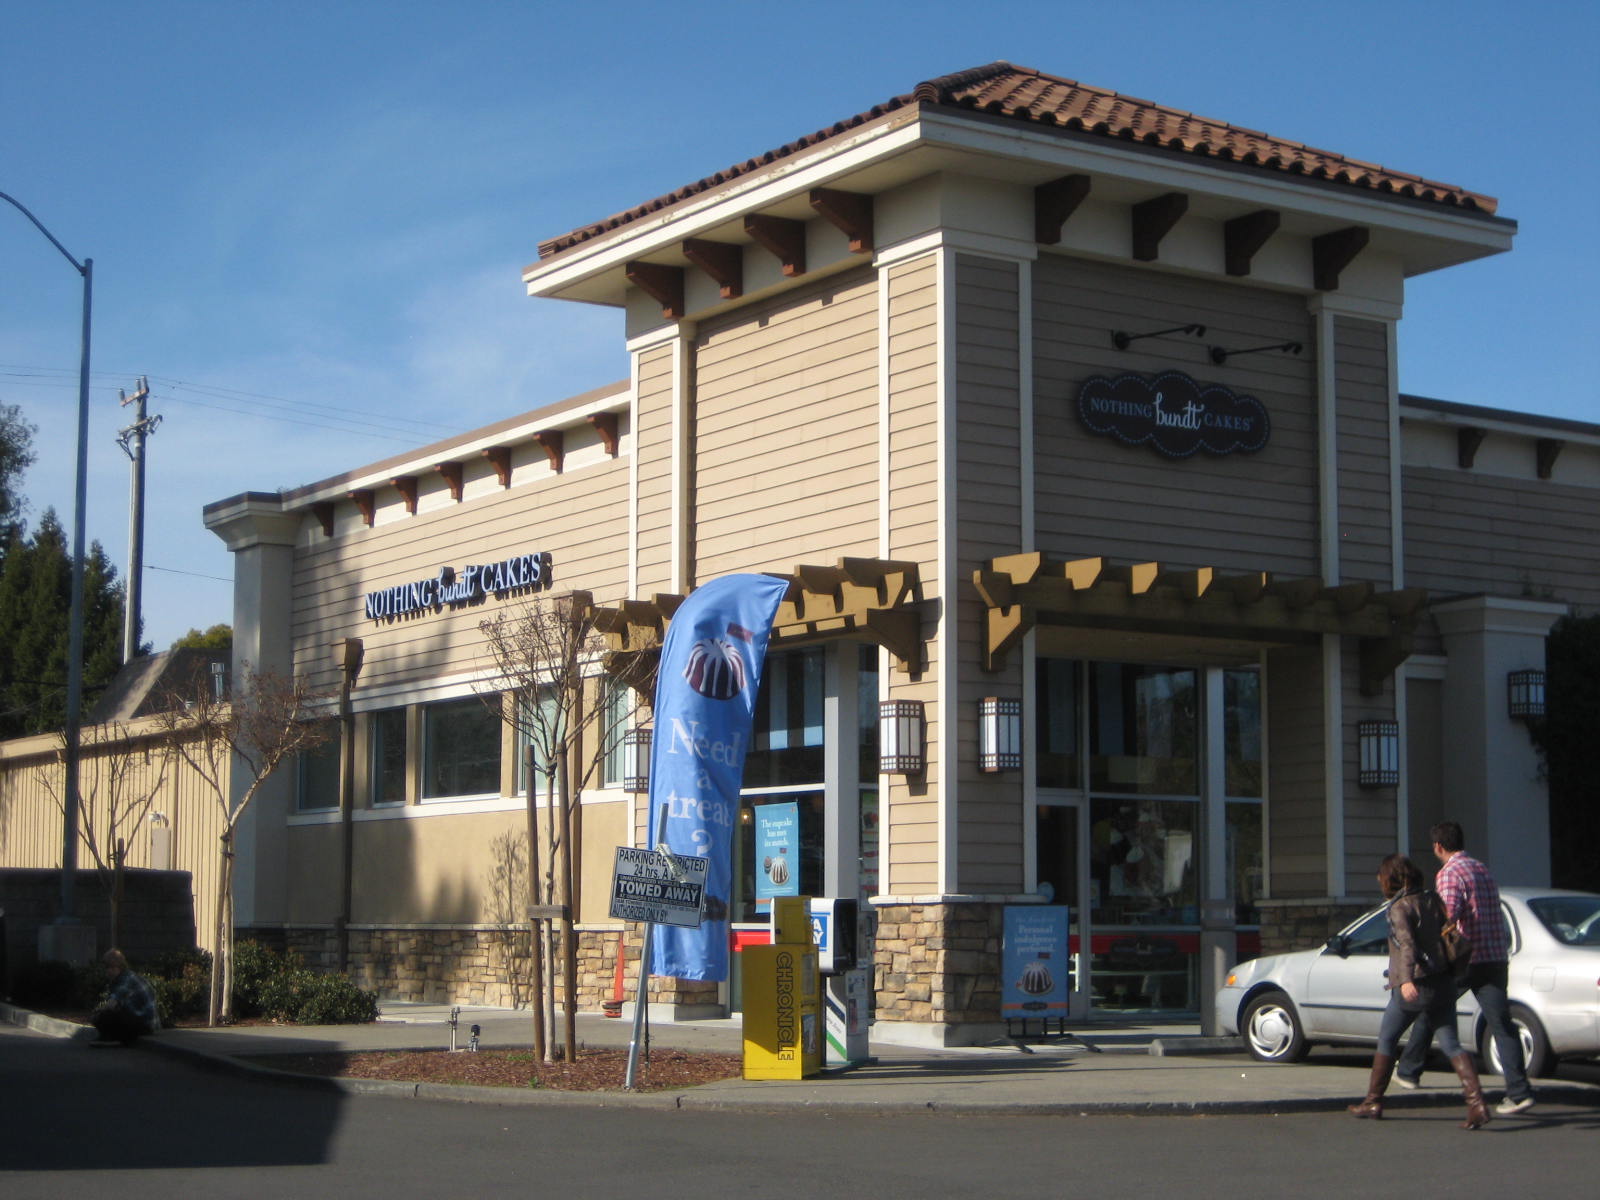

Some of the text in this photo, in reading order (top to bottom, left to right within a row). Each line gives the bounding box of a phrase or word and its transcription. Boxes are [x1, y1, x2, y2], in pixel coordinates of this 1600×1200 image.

[1090, 391, 1252, 431] NOTHING bundt CAKES
[364, 552, 543, 619] NOTHING bundt CAKES
[666, 717, 740, 768] Need
[697, 774, 711, 791] a
[618, 849, 706, 872] PARKING RERICTED
[634, 863, 643, 876] 24
[645, 865, 660, 880] hrs.
[618, 880, 663, 898] TOWED
[664, 886, 699, 903] AWAY
[612, 903, 646, 919] AUTHORIZED
[776, 951, 794, 1061] CHRONICLE
